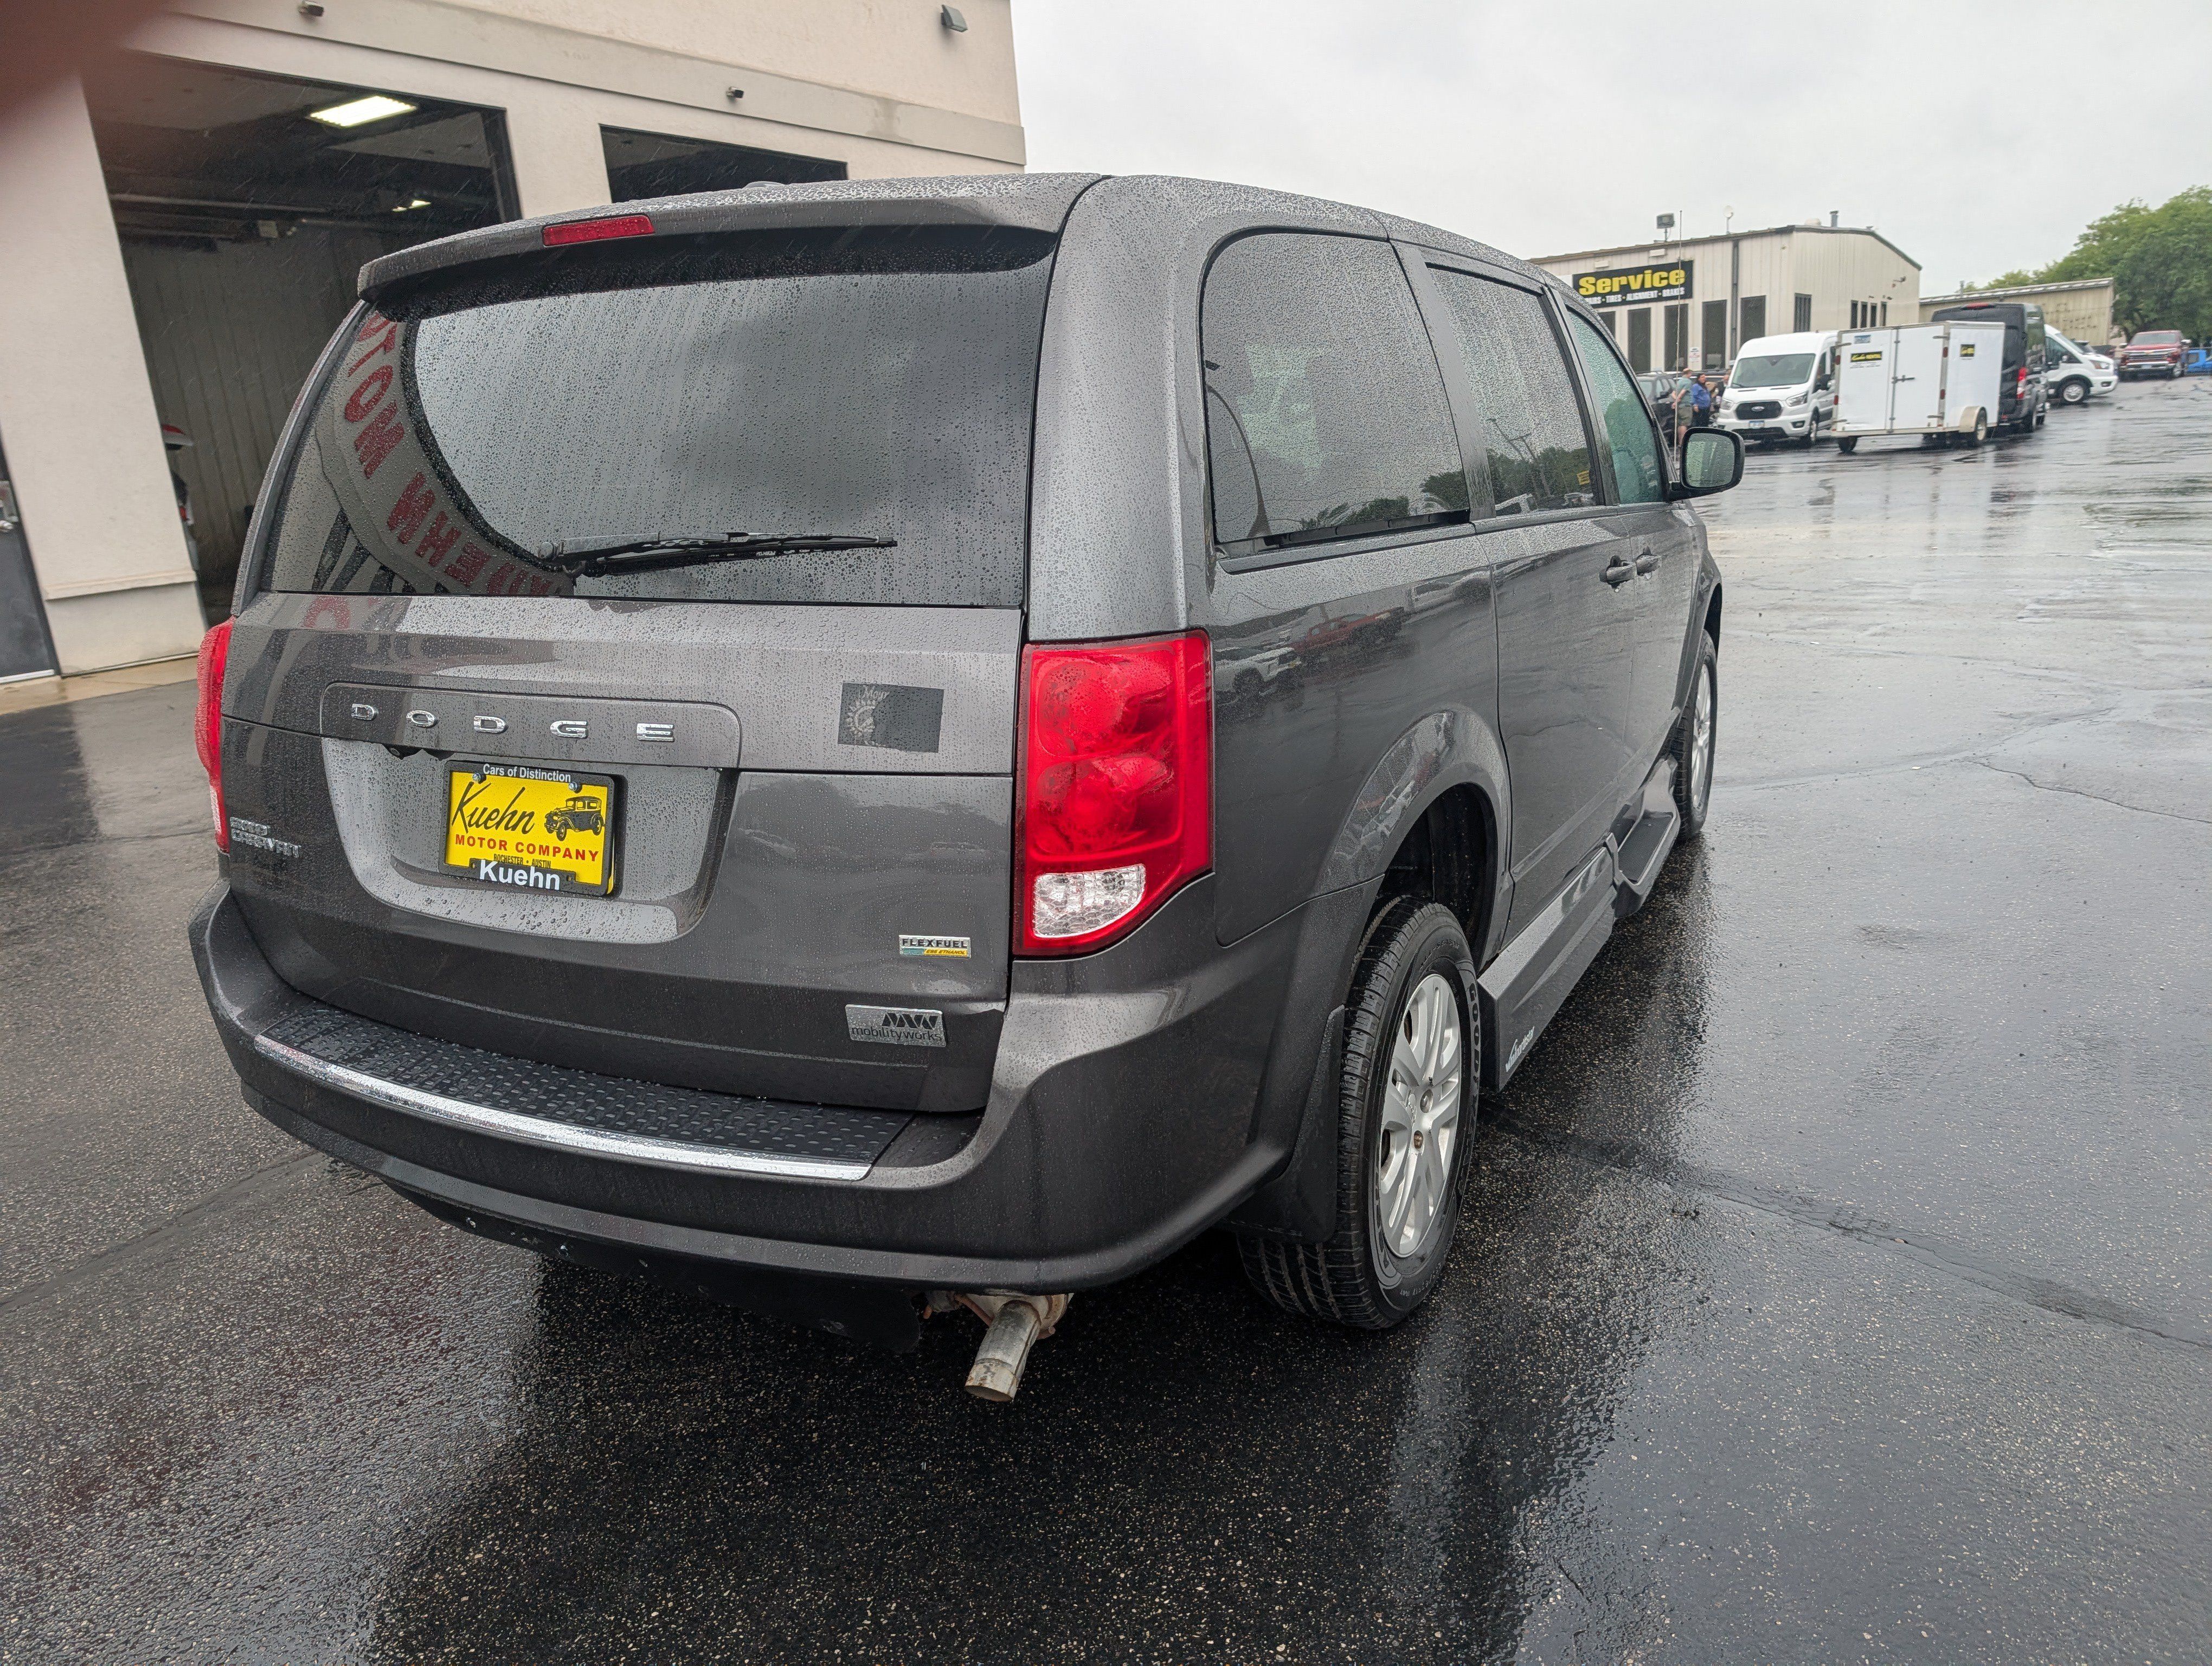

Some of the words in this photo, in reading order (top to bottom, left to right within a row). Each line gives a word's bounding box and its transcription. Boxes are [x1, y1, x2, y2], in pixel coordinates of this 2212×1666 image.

[1578, 270, 1686, 296] Service
[350, 703, 675, 742] DODGE
[483, 763, 505, 776] Cars
[507, 766, 517, 777] of
[519, 767, 571, 783] Distinction
[452, 781, 536, 835] Kuehn
[455, 834, 507, 851] MOTOR
[515, 842, 599, 862] COMPANY
[493, 853, 524, 865] ROCHESTER
[531, 858, 551, 868] AUSTIN
[479, 860, 560, 890] Kuehn
[902, 938, 968, 948] FLEXFUEL
[852, 1026, 943, 1041] mobilityworks
